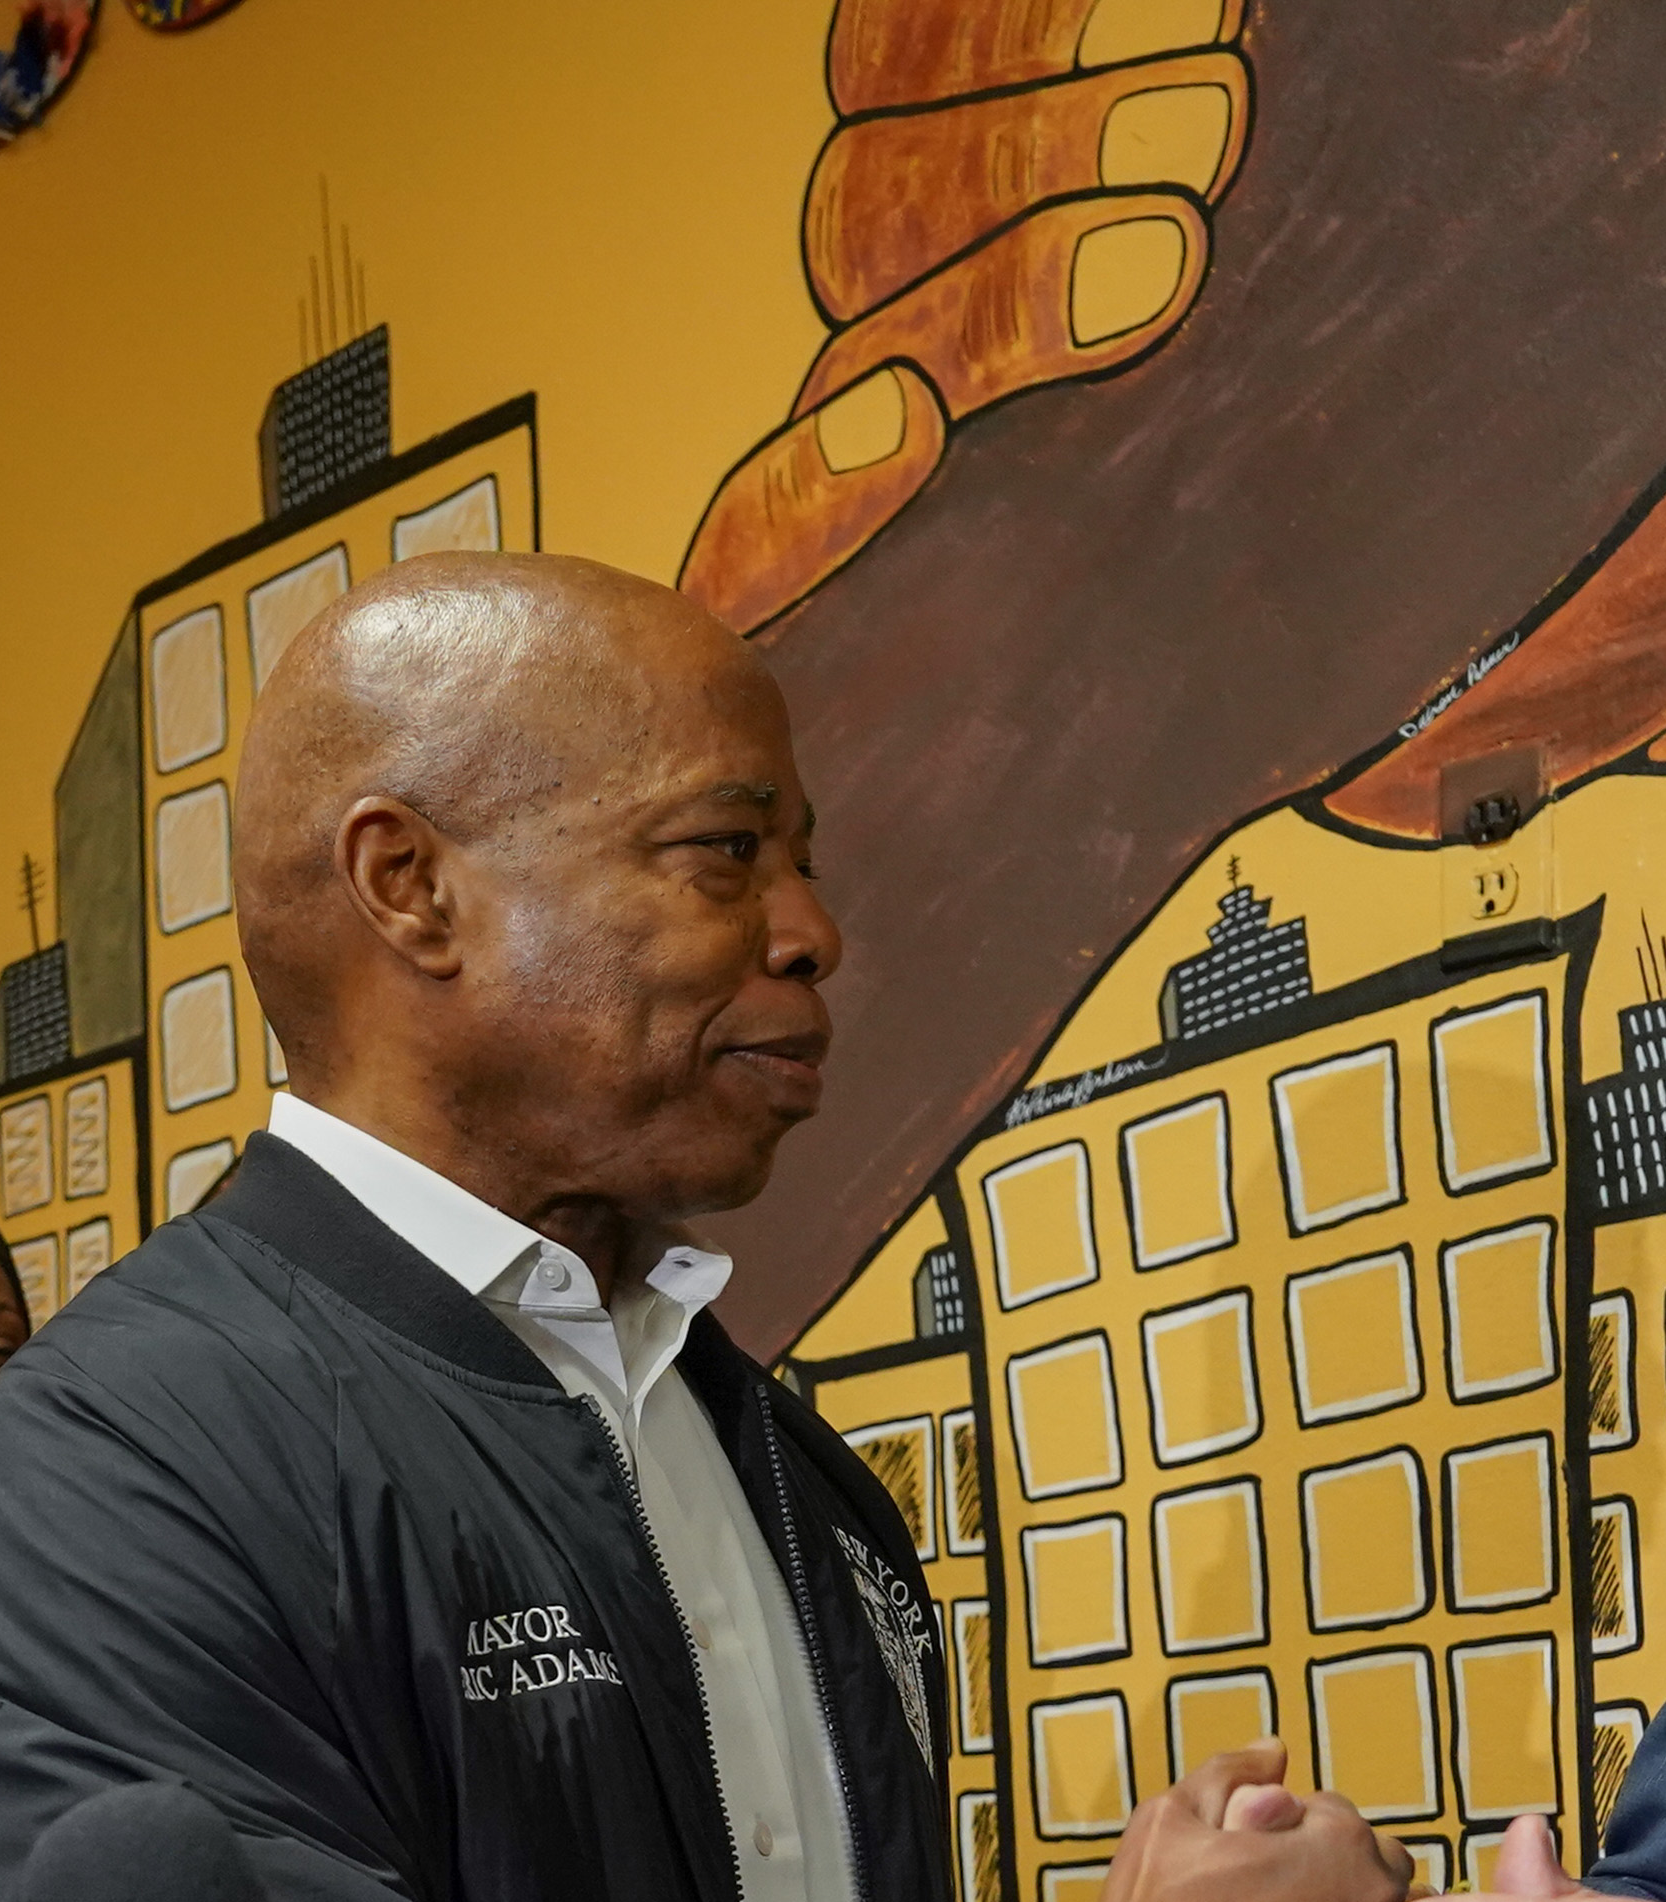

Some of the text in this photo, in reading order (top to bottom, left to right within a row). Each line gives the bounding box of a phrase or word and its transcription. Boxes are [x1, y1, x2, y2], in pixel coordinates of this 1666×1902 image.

[874, 1556, 933, 1659] YORK
[460, 1649, 623, 1701] RIC ADAMS
